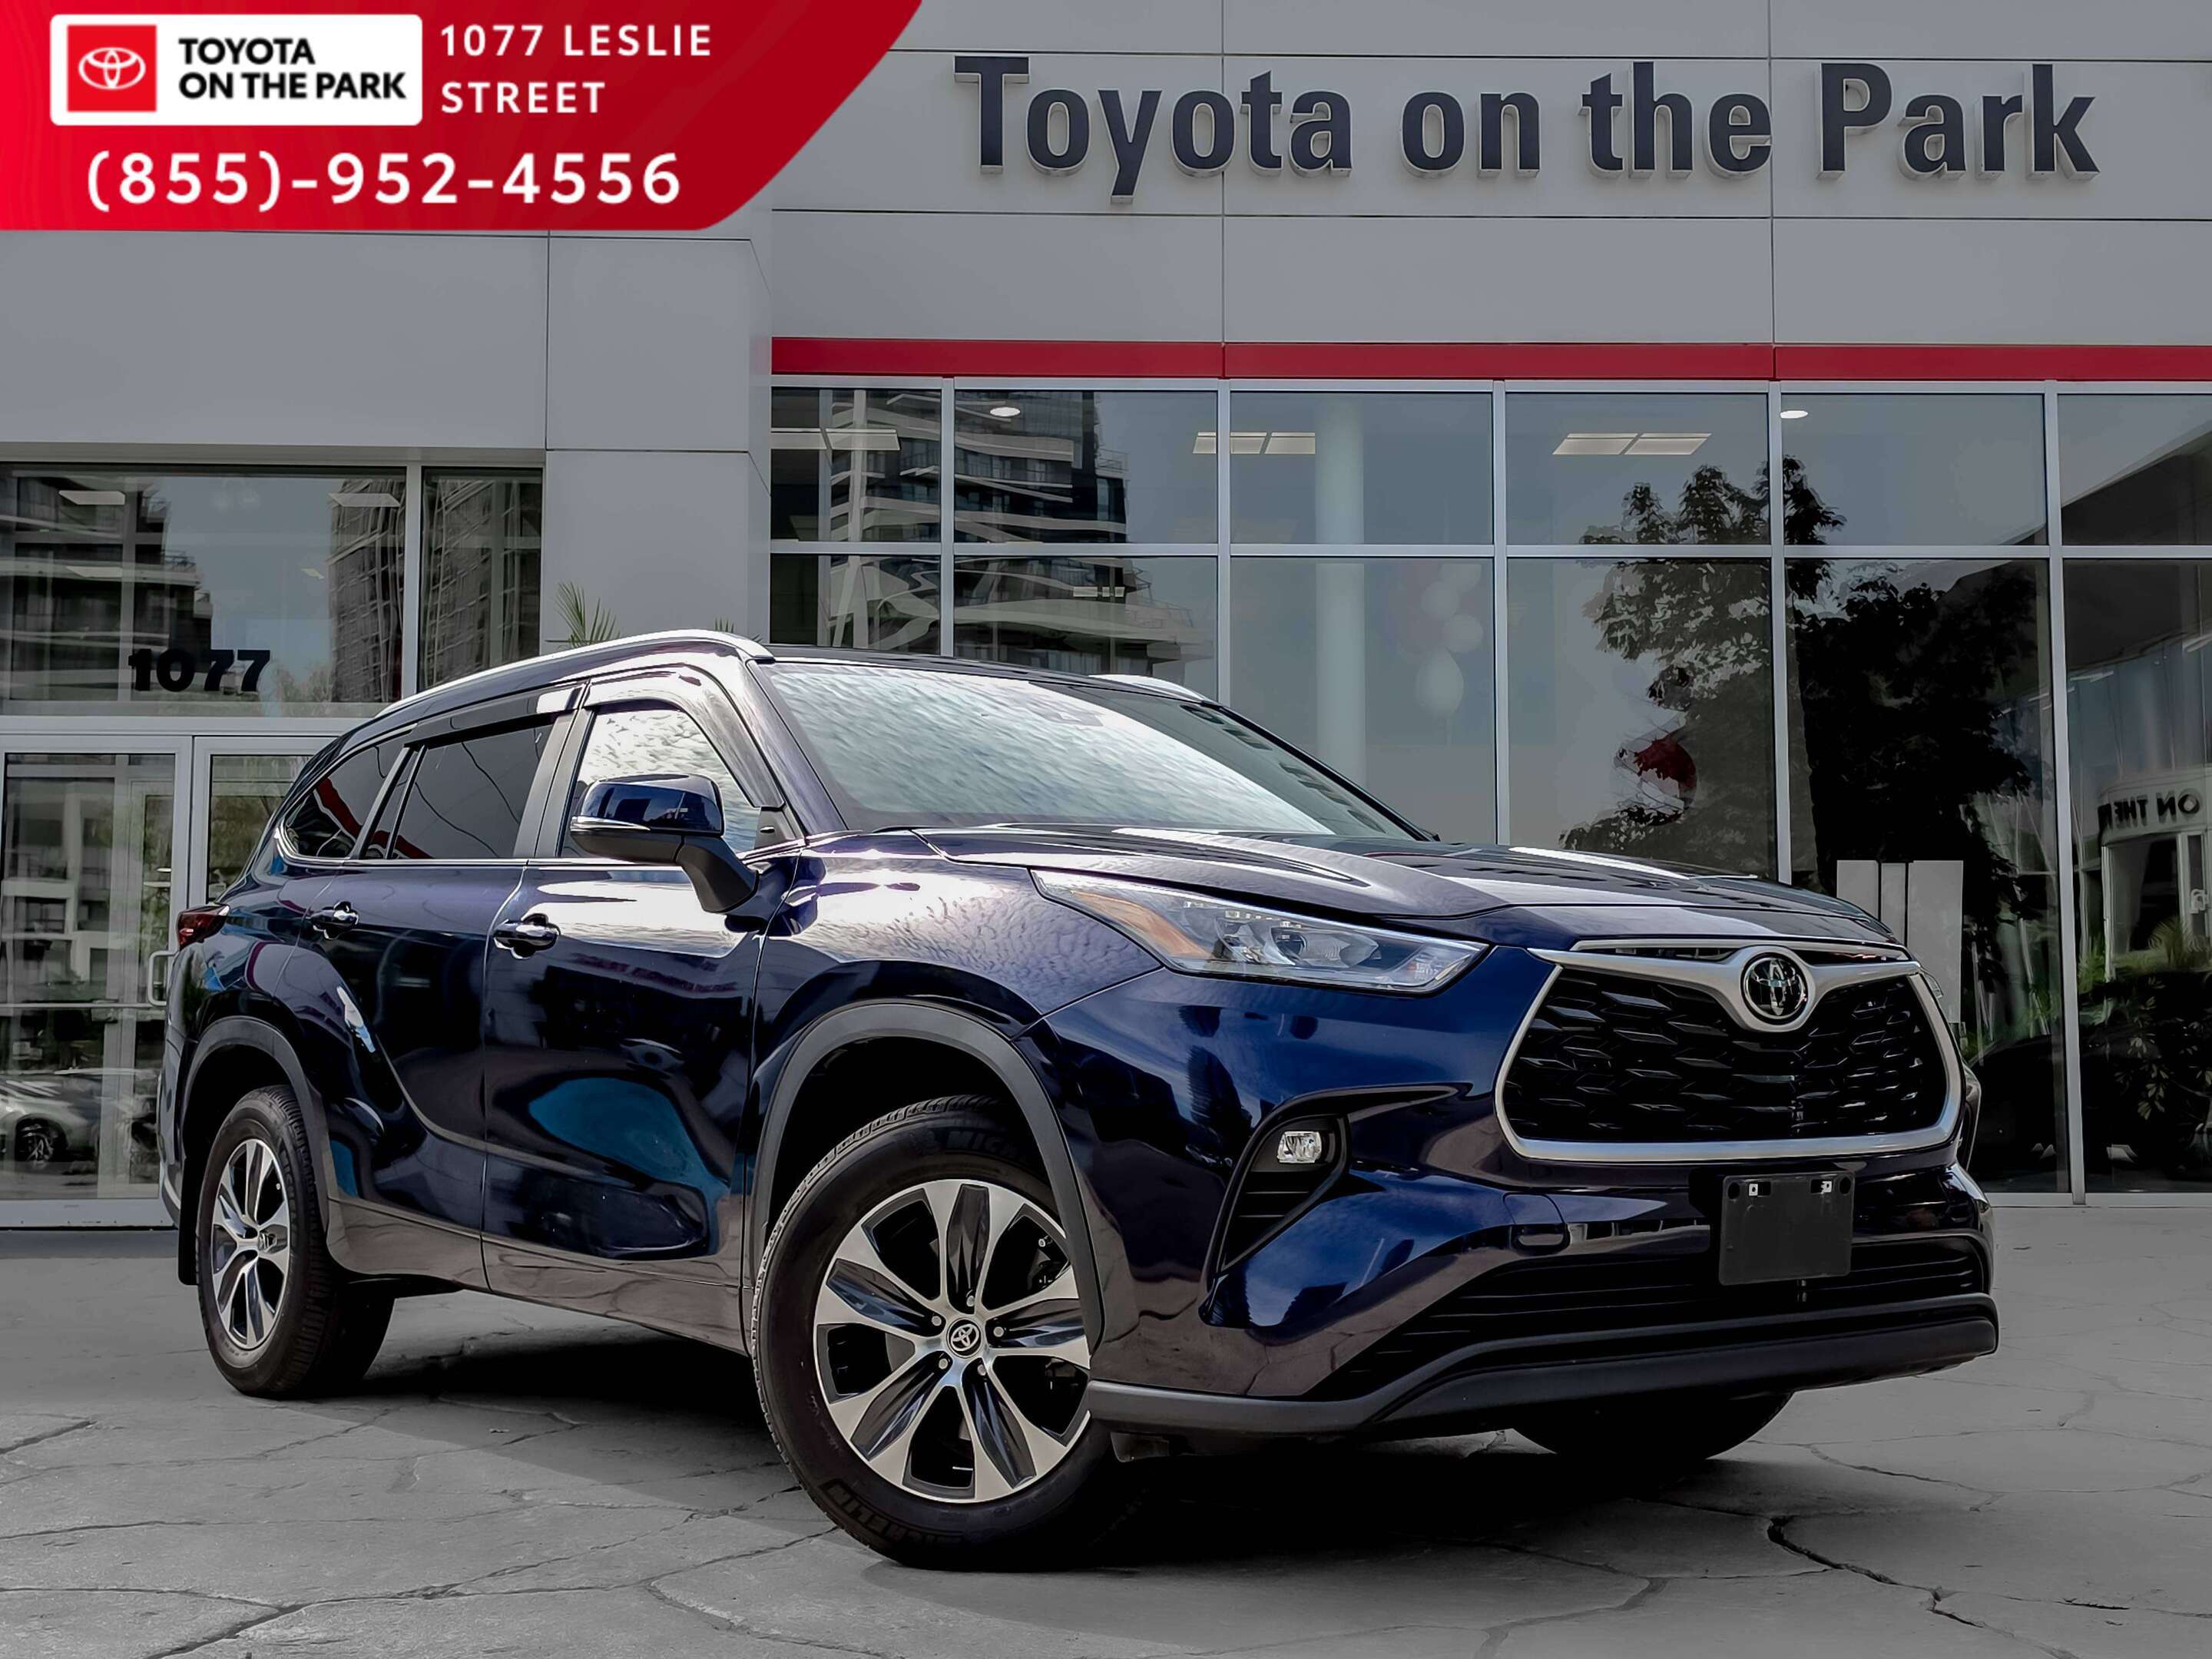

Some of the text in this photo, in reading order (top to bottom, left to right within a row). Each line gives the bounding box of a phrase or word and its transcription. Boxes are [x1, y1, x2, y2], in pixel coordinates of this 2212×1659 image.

[953, 55, 2100, 201] Toyota on the Park
[128, 648, 270, 692] 1077
